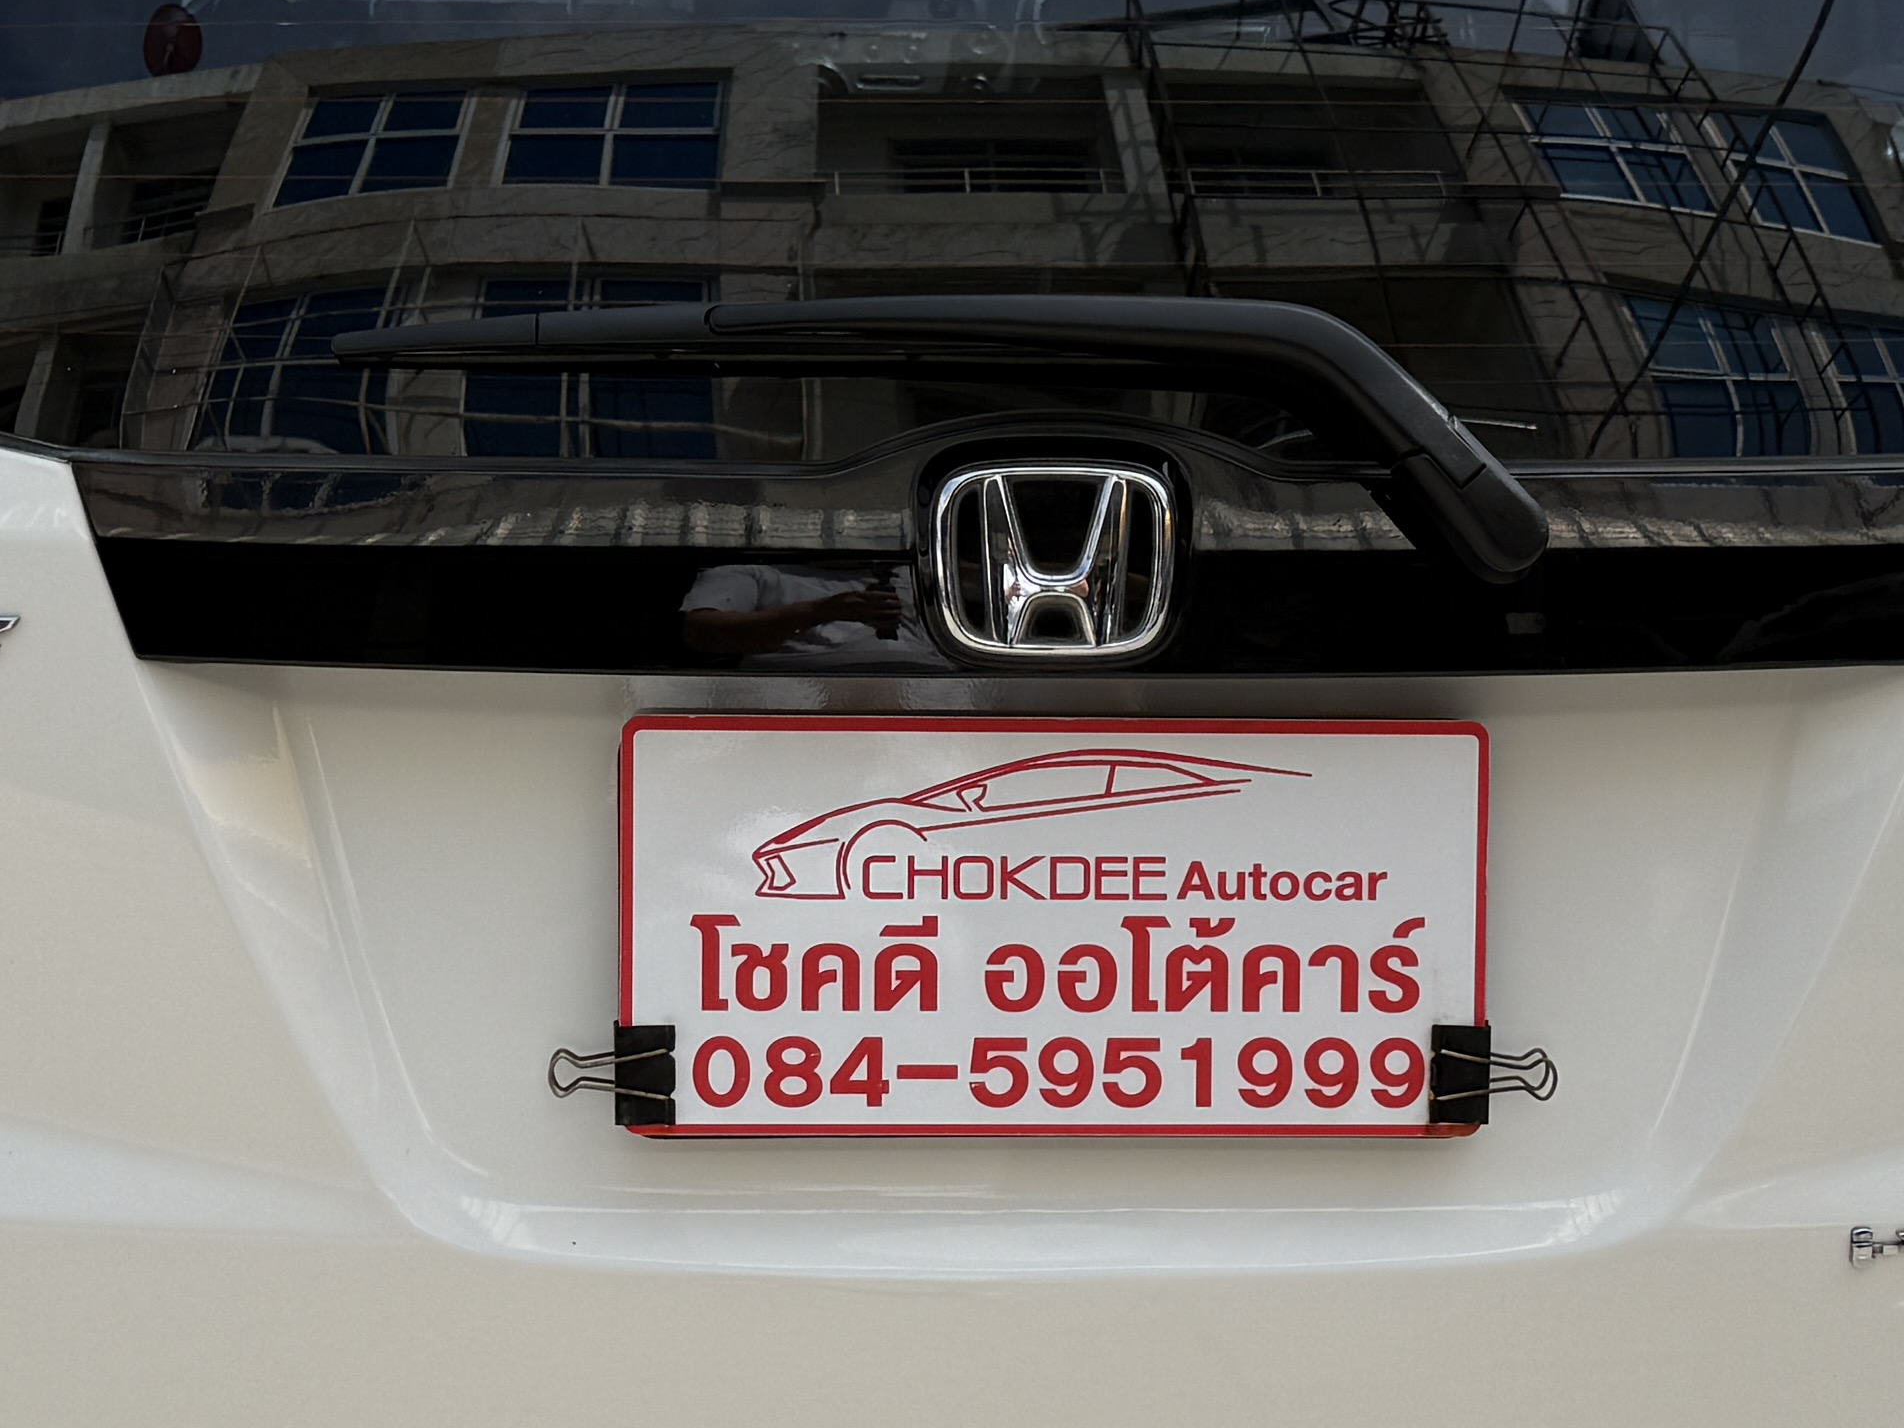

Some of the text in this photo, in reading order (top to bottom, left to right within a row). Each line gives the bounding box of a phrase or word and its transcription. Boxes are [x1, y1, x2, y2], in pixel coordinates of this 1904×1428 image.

[861, 855, 1388, 903] CHOKDEE Autocar
[690, 915, 1426, 1013] โชคดี ออโต้คาร์
[693, 1036, 1424, 1109] 084-5951999
